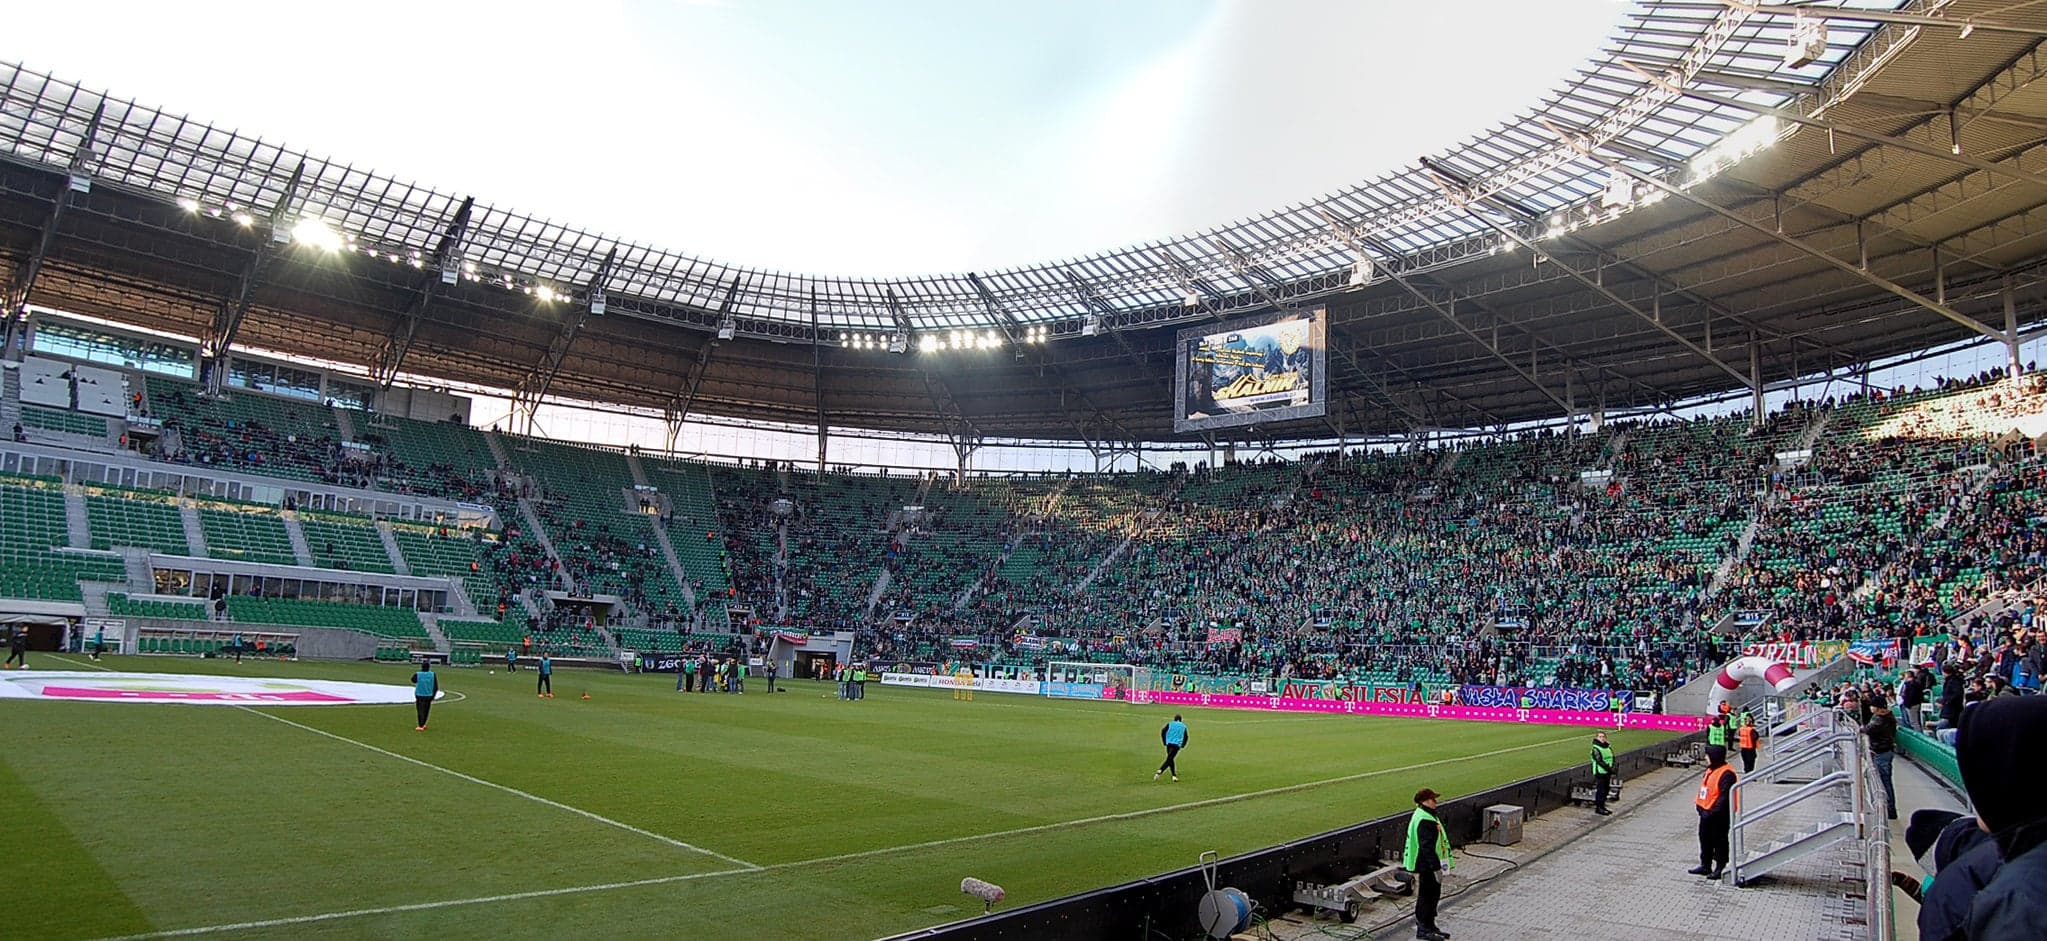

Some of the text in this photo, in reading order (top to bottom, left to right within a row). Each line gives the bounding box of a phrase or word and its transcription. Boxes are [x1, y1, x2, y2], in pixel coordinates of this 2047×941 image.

[1744, 642, 1818, 665] STRZELIN
[1281, 683, 1424, 704] AVE SILESIA
[1524, 689, 1609, 712] SHARKS
